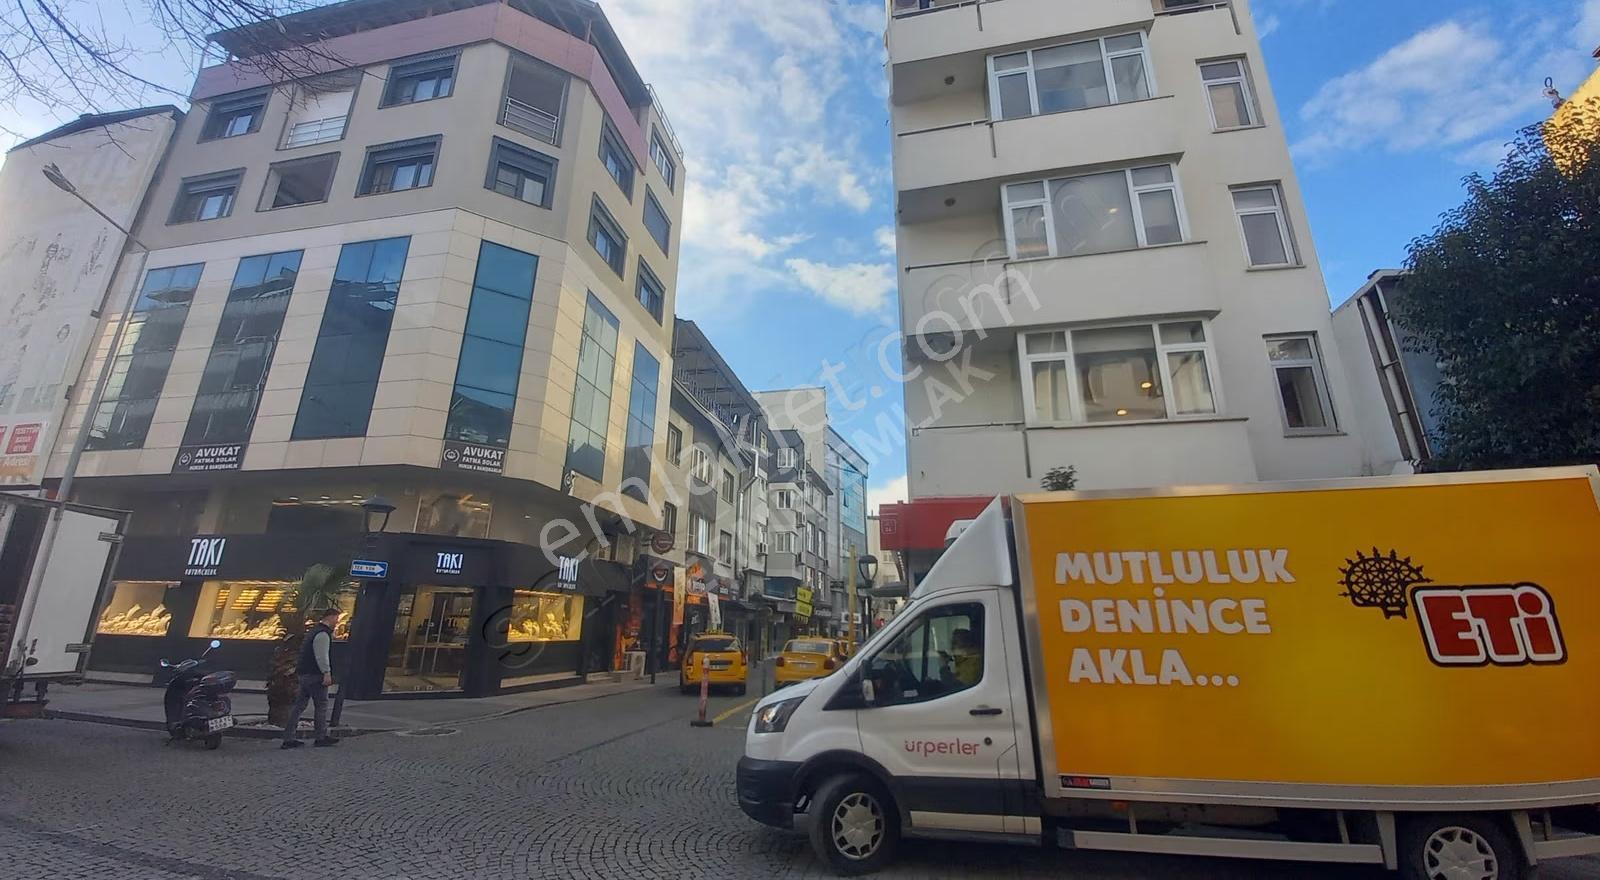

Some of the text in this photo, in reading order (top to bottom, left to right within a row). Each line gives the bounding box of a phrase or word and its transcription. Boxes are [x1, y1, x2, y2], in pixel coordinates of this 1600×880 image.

[195, 446, 241, 457] AVUKAT
[463, 446, 505, 460] AVUKAT
[187, 538, 226, 568] TAKI
[437, 552, 463, 569] TAKI
[558, 556, 578, 582] TAKI
[1055, 549, 1296, 585] MUTLULUK
[1059, 587, 1272, 634] DENİNCE
[1068, 648, 1240, 687] AKLA...
[905, 738, 980, 757] ürperler
